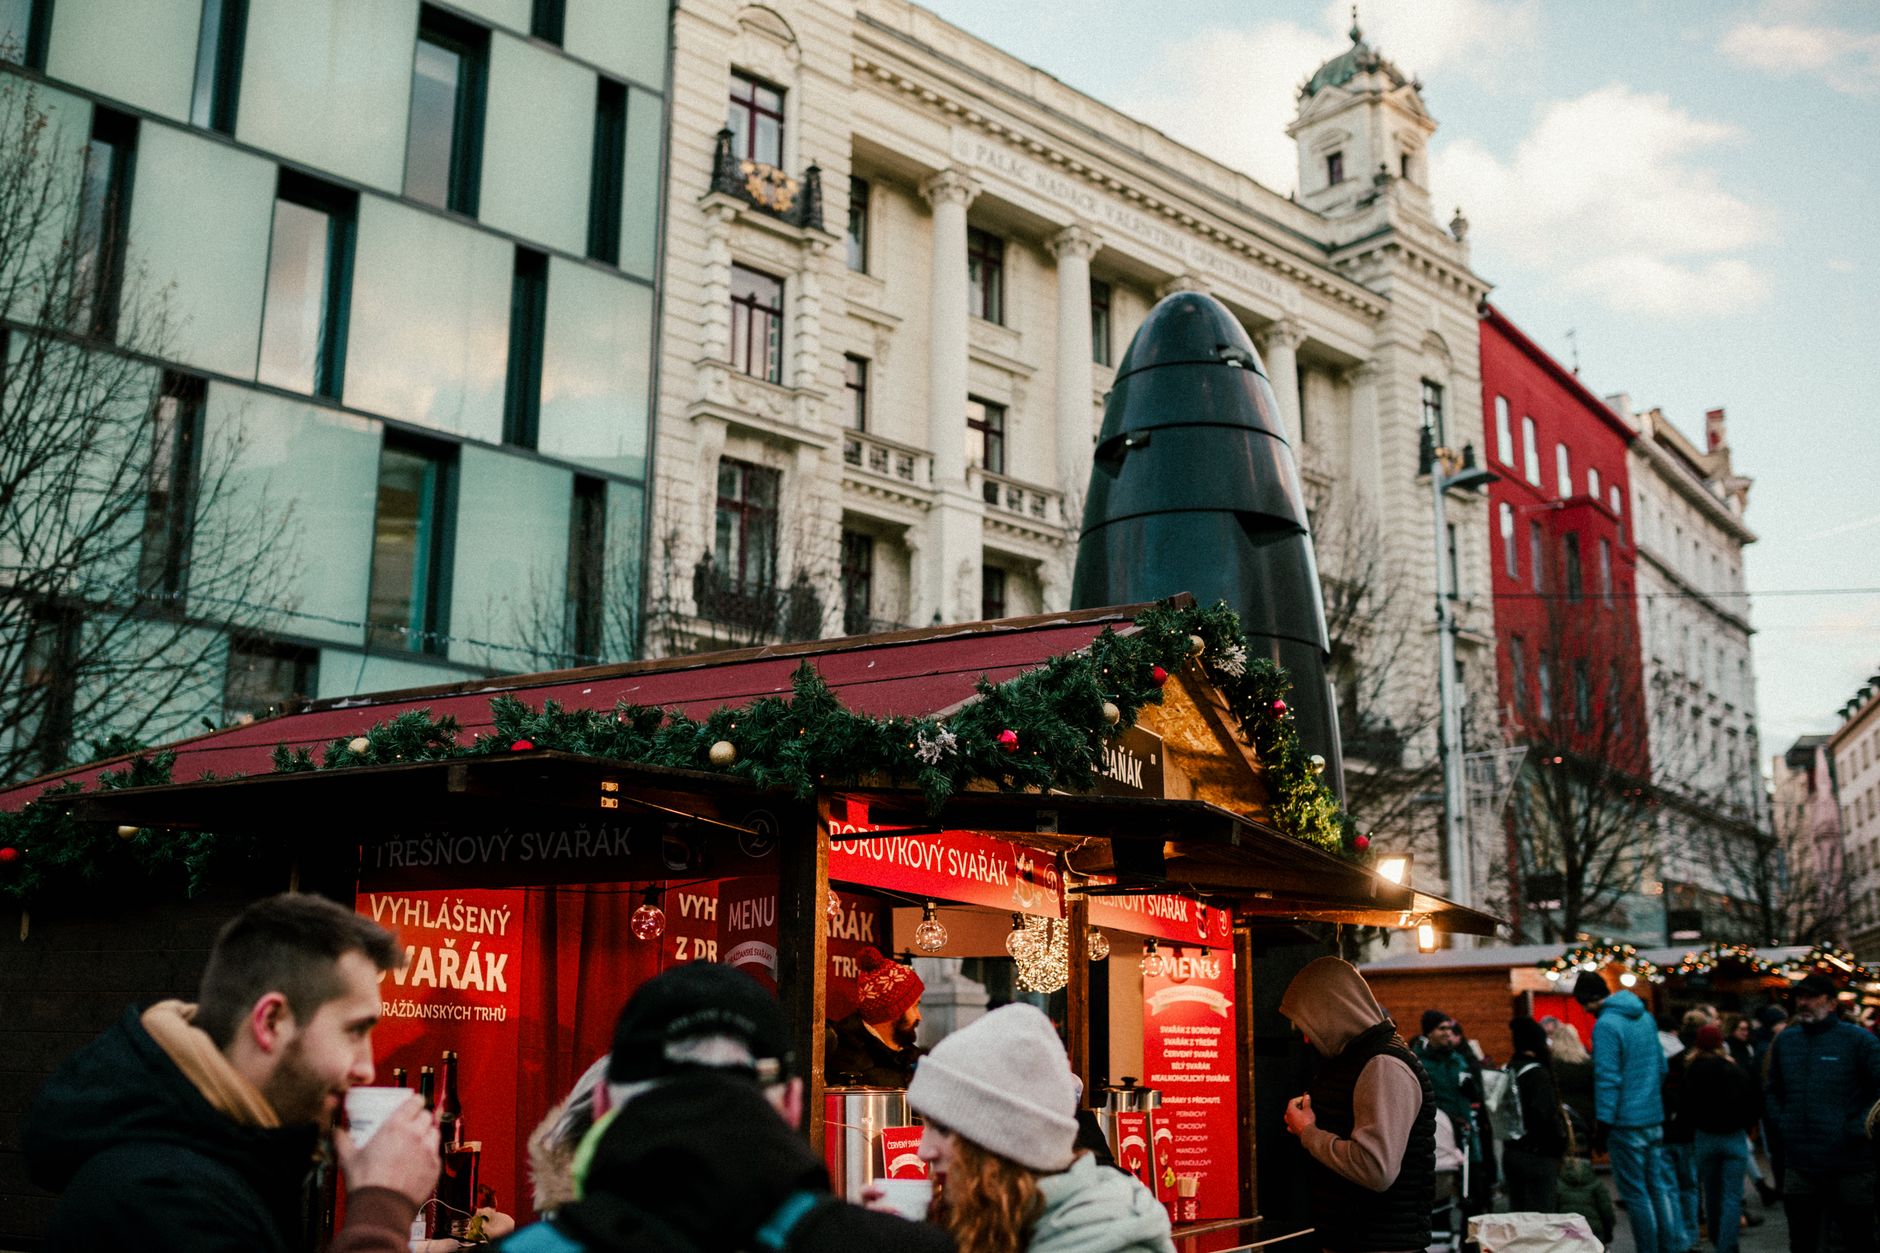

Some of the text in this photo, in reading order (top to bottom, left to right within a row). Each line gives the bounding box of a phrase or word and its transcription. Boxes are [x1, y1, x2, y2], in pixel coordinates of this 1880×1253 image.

[1091, 738, 1143, 790] ĎAŇÁK
[519, 823, 632, 861] SVAŘÁK
[948, 849, 1009, 887] SVAŘÁK
[369, 894, 511, 936] VYHLÁŠENÝ
[728, 896, 775, 932] MENU
[1147, 894, 1189, 922] SVAŘÁK
[377, 938, 509, 993] VAŘÁK
[675, 936, 688, 961] Z
[1160, 957, 1220, 980] MENU
[474, 1004, 507, 1022] TRHŮ
